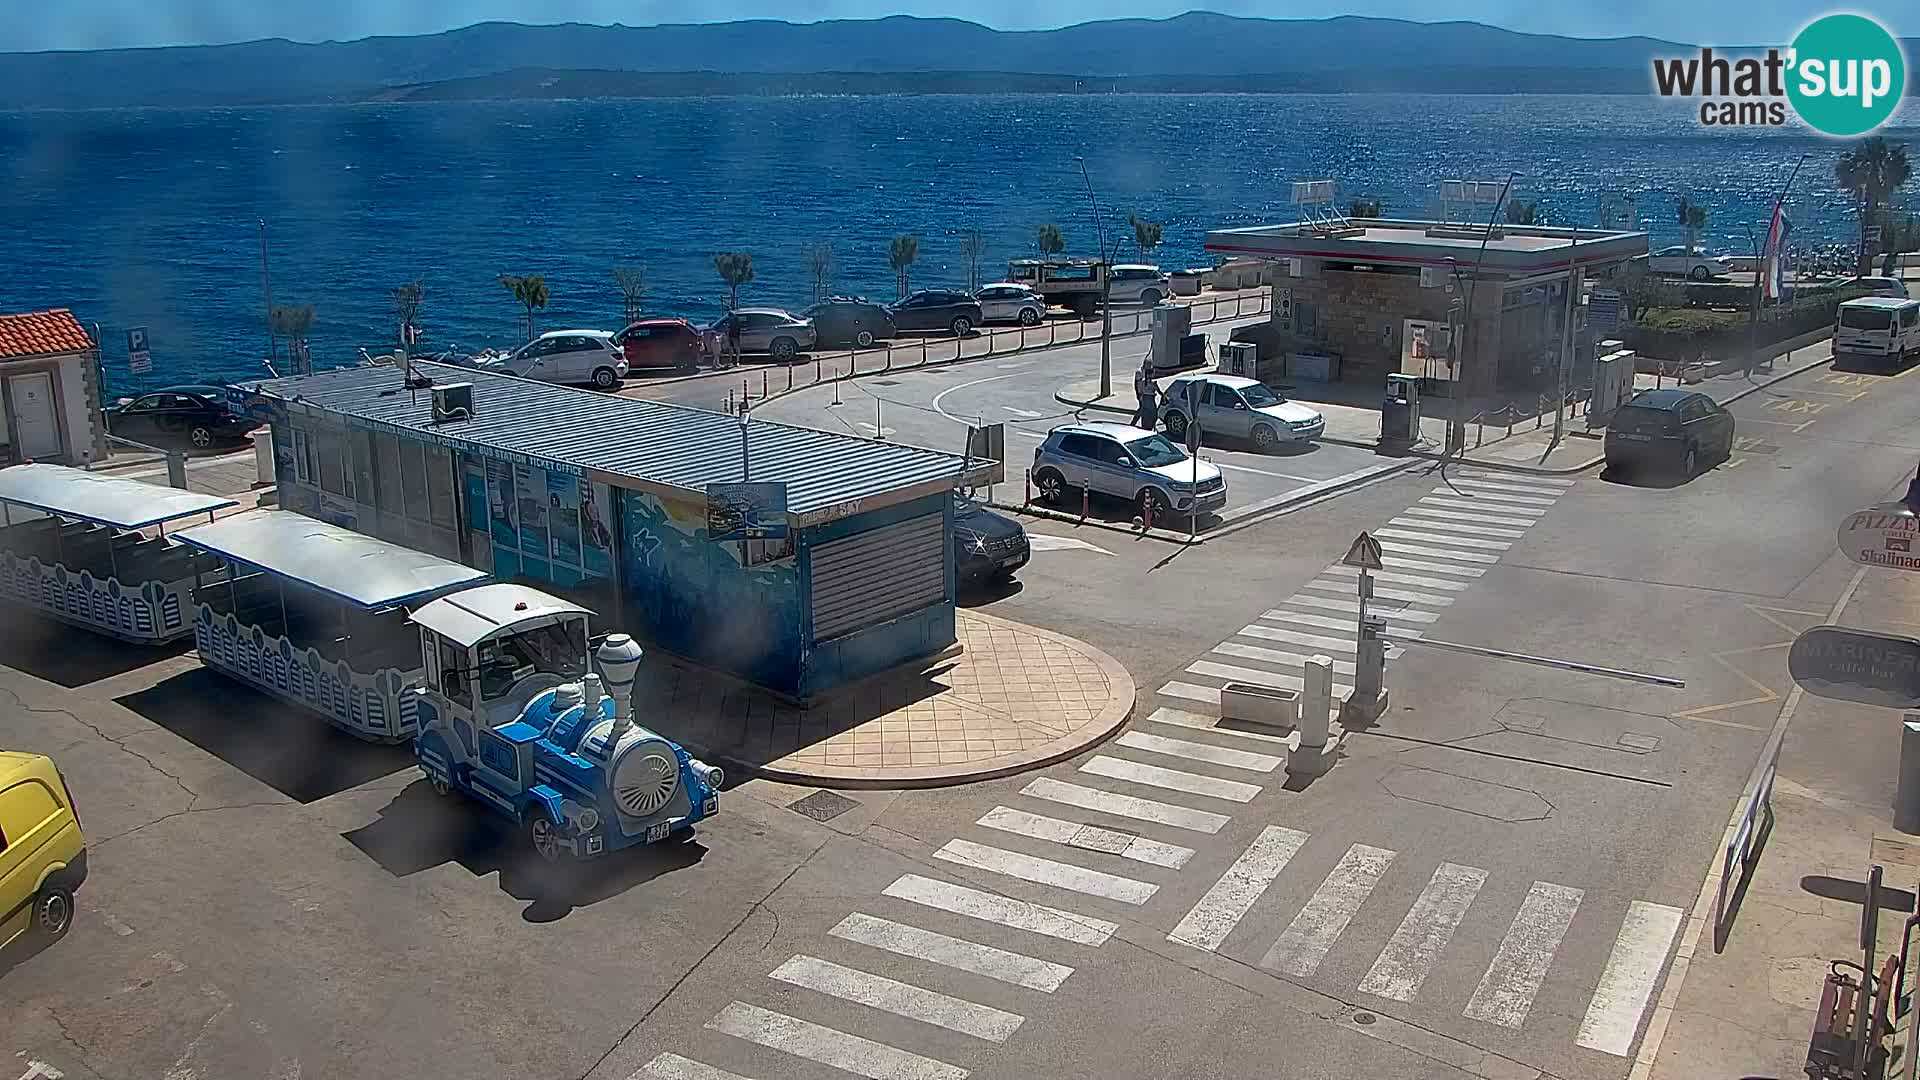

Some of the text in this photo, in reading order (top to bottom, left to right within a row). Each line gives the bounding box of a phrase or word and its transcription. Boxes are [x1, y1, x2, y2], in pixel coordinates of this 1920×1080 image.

[131, 330, 144, 349] P
[437, 435, 468, 451] POSTAJA
[479, 445, 494, 458] BUS
[495, 449, 527, 465] STATION
[528, 456, 555, 471] TICKET
[556, 463, 583, 477] OFFICE
